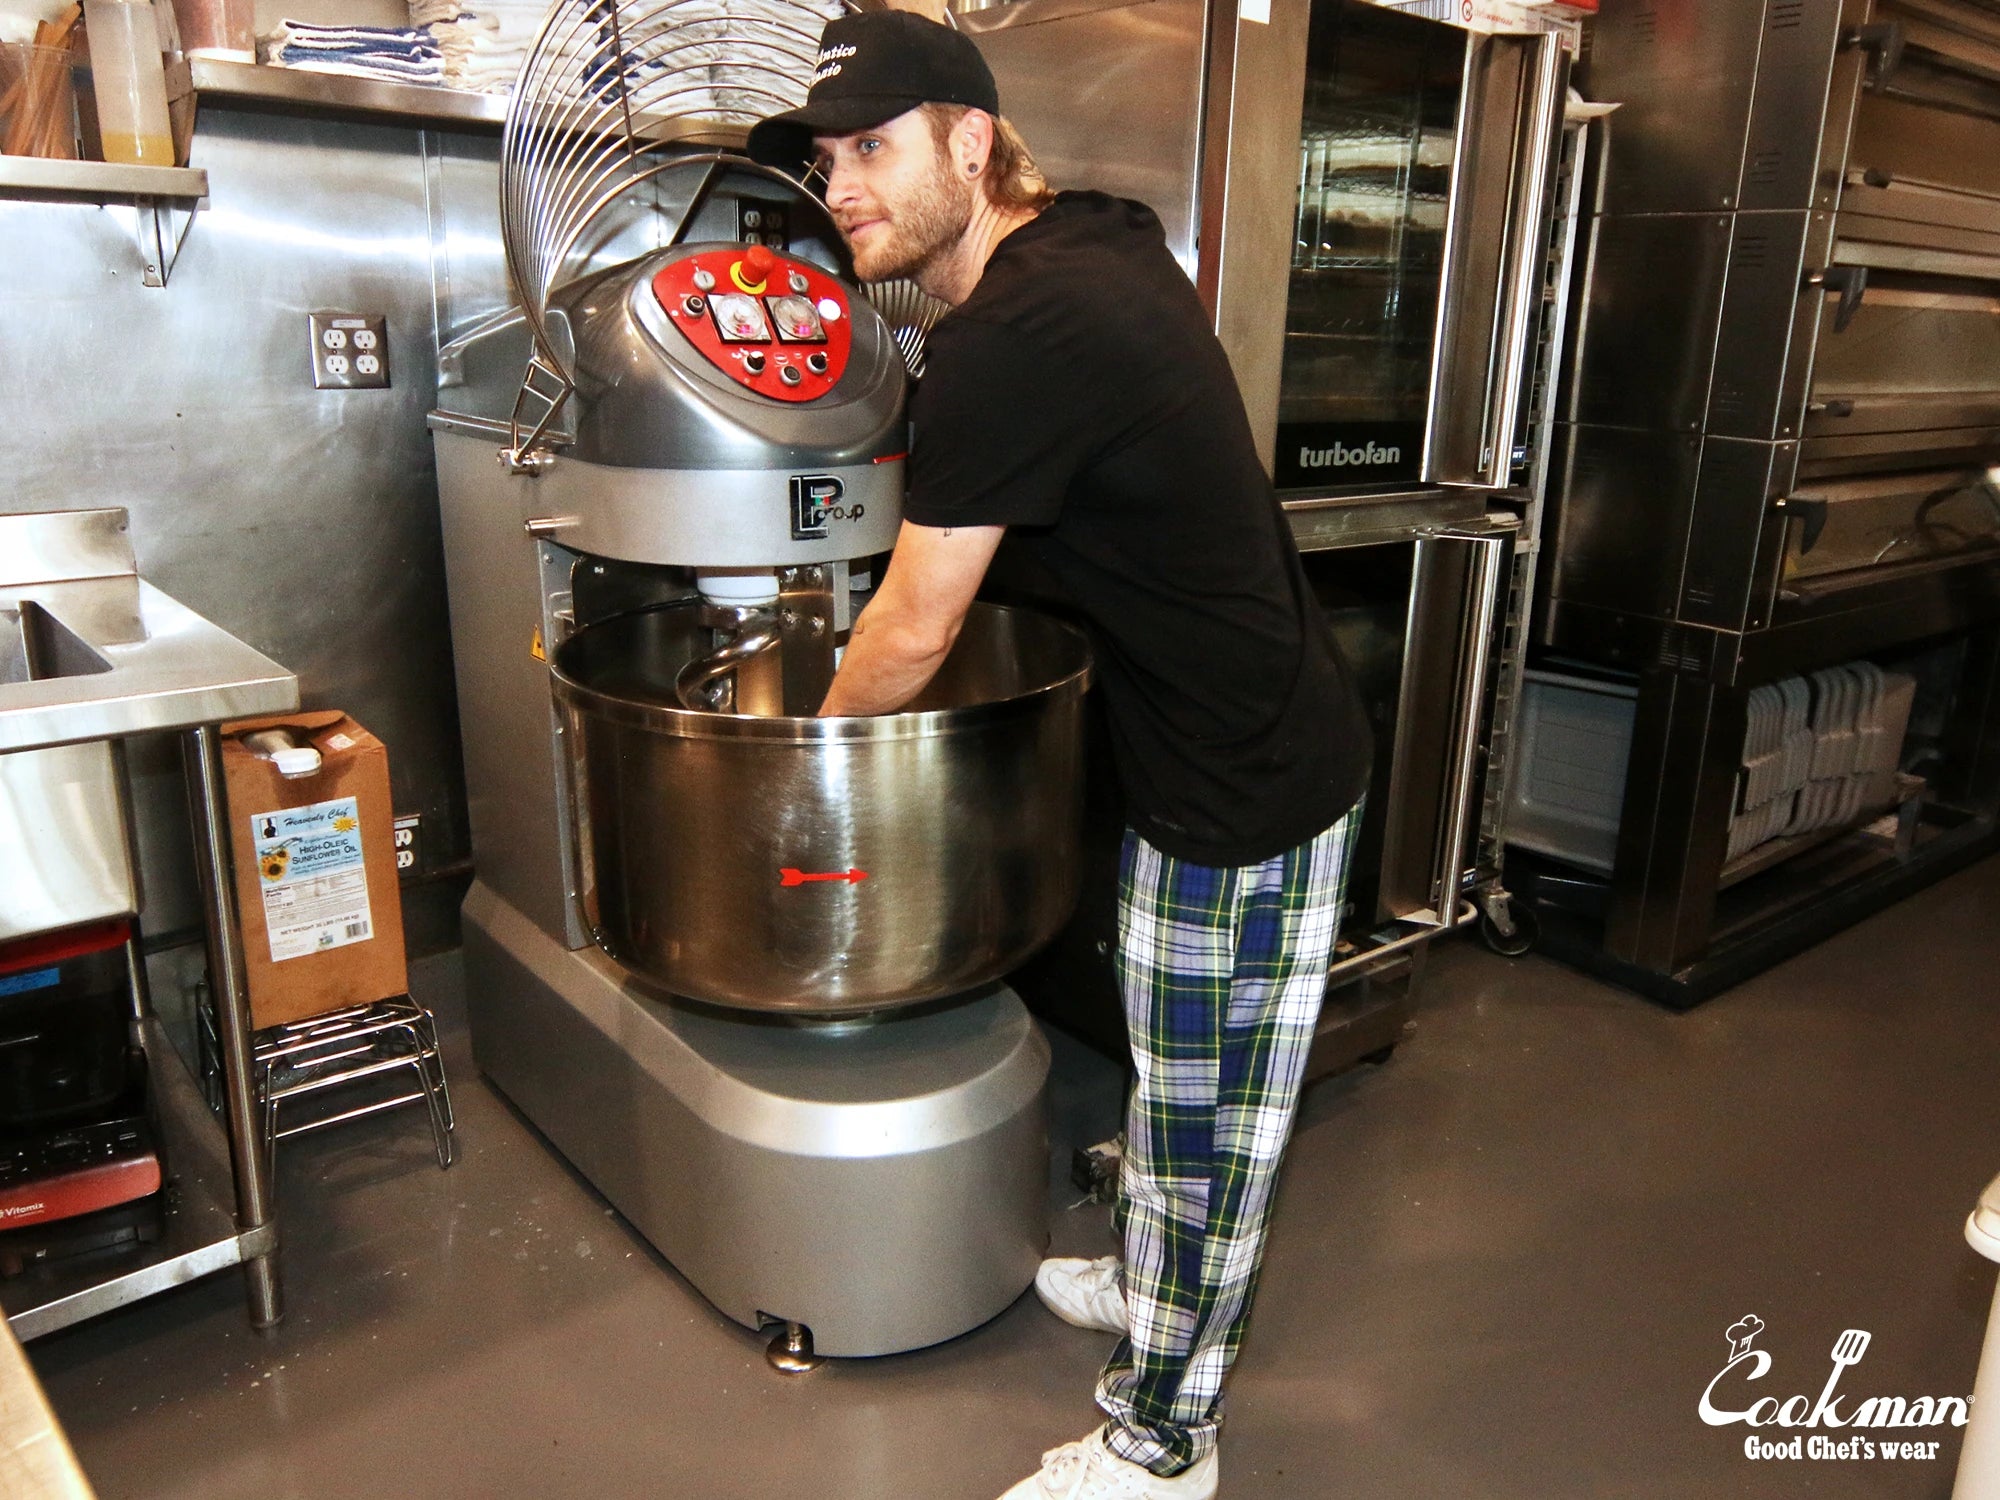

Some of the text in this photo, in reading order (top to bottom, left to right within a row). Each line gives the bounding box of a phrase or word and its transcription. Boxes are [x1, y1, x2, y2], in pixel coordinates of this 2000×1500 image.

[1300, 441, 1400, 468] turbofan
[284, 807, 350, 826] Heavenly Chef
[292, 845, 357, 865] SUNFLOWER OIL
[4, 1202, 44, 1216] Vitamix
